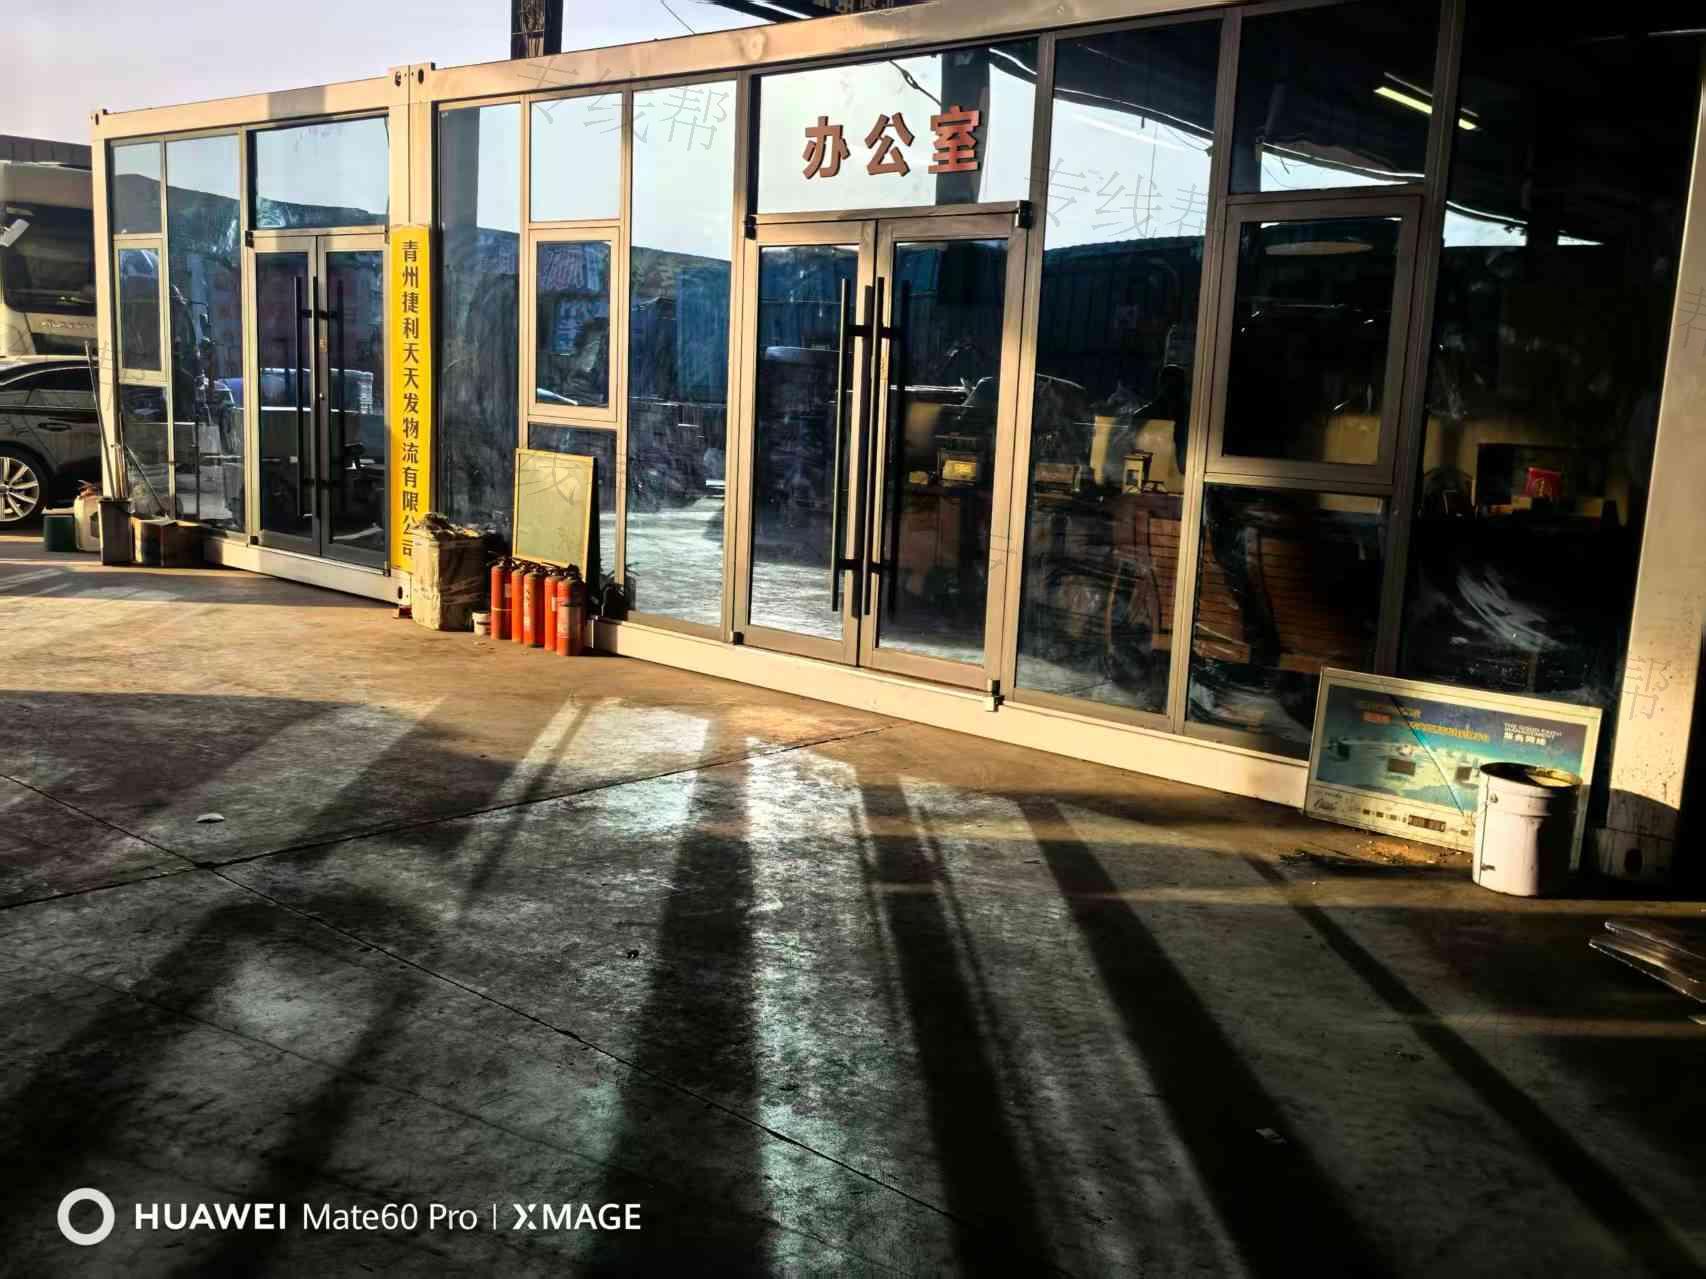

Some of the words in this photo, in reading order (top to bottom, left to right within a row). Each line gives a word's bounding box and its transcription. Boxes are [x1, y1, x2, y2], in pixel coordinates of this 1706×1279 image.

[802, 105, 982, 180] 办公室
[401, 239, 420, 557] 青州捷利天天发物流有限公司
